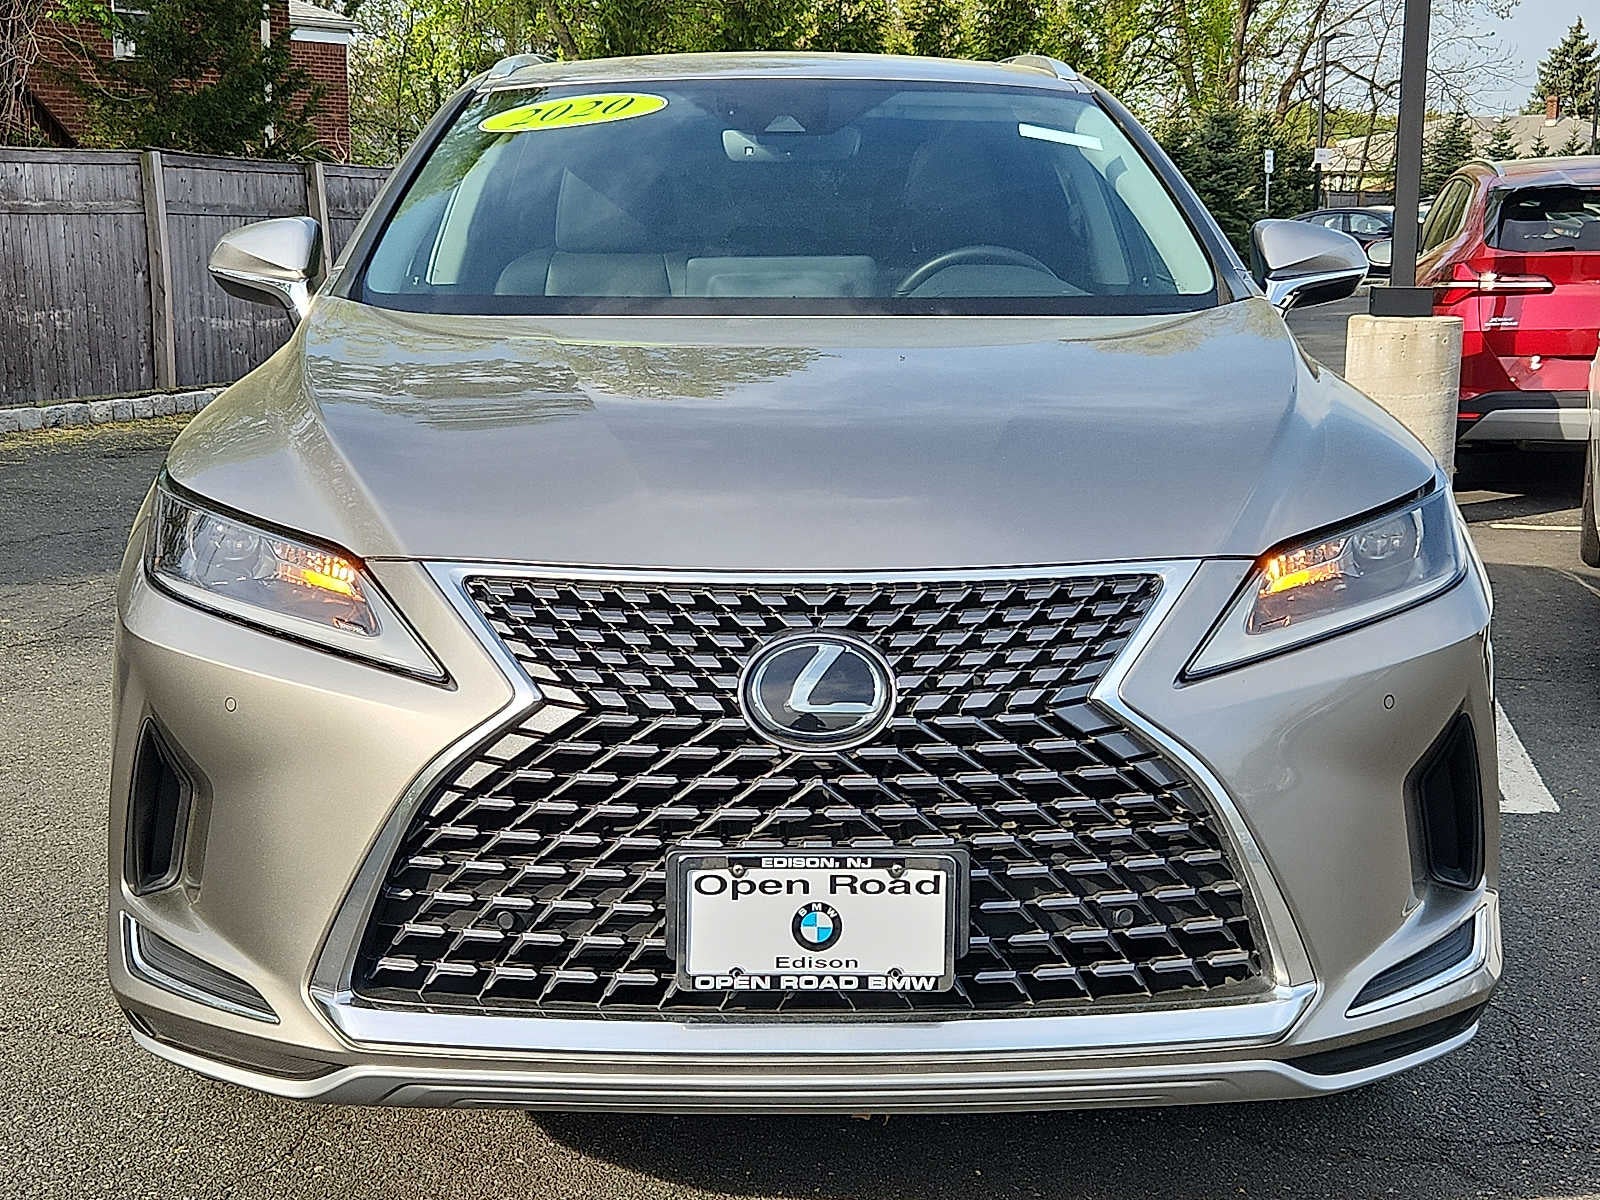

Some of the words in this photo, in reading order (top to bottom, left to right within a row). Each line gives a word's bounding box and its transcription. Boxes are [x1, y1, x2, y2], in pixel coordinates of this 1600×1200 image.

[505, 97, 635, 128] 2020
[761, 857, 840, 870] EDISON,
[846, 857, 872, 869] NJ
[694, 874, 811, 901] Open
[829, 874, 941, 896] Road
[798, 902, 838, 918] BMW
[775, 956, 859, 969] Edison
[694, 975, 778, 991] OPEN
[780, 975, 860, 991] ROAD
[867, 975, 936, 991] BMW
